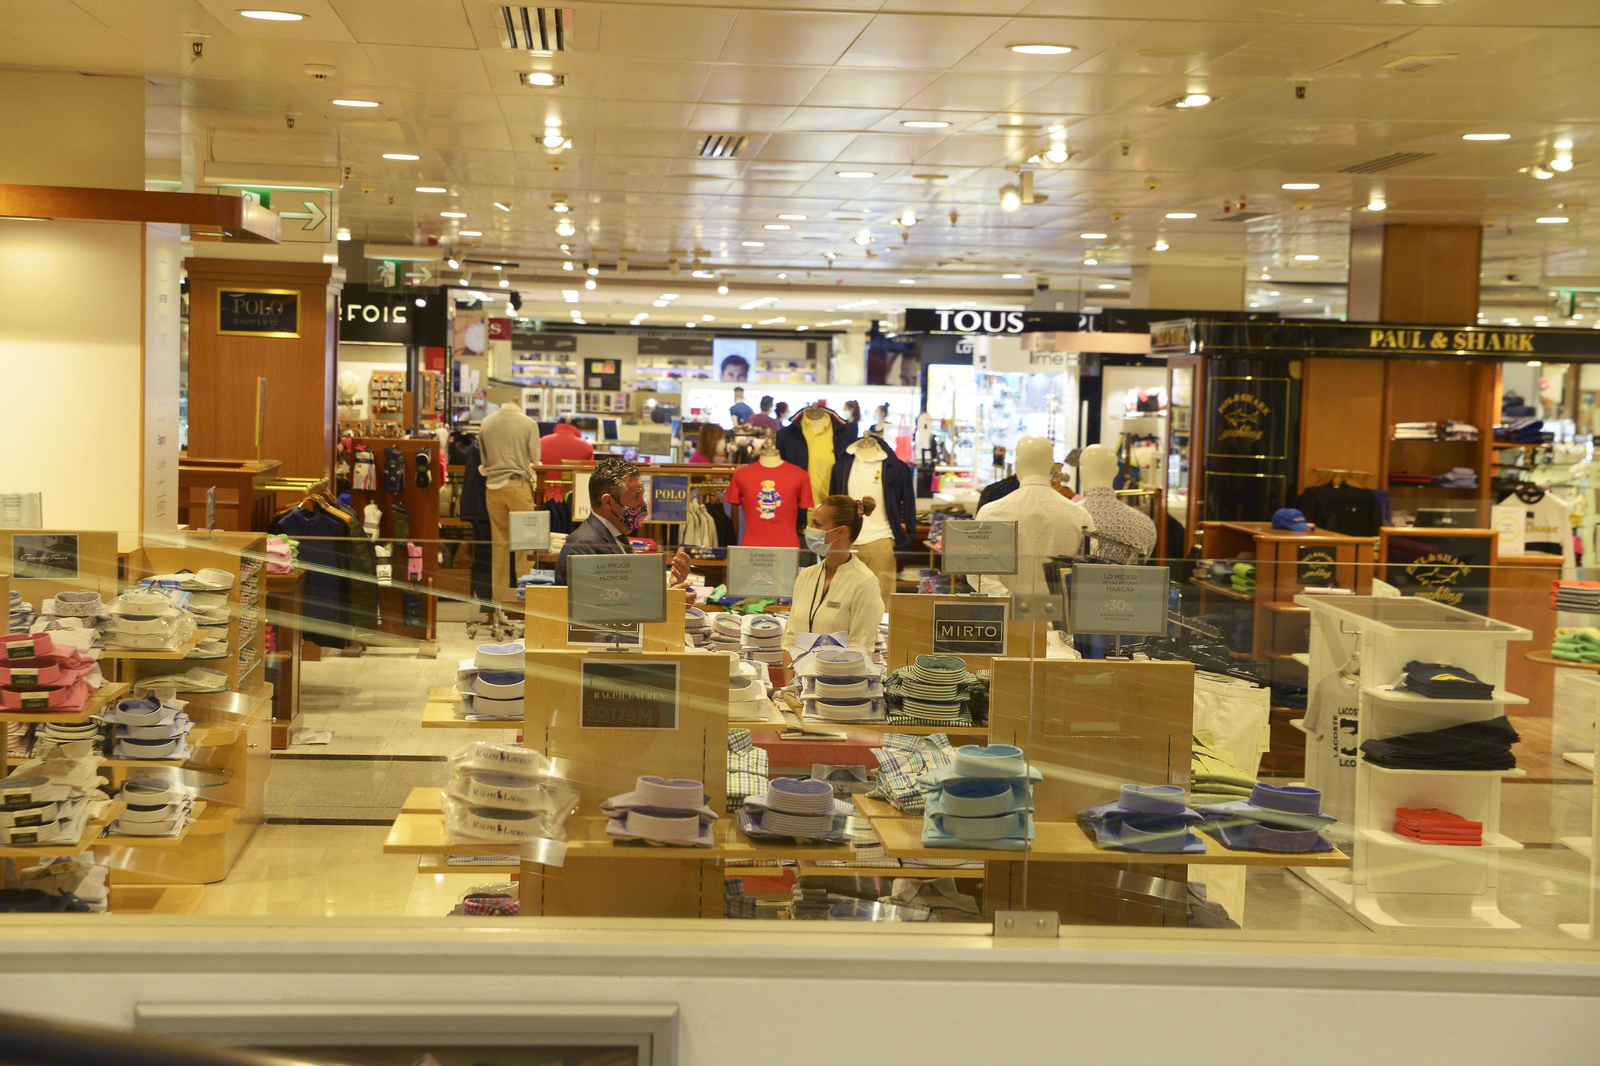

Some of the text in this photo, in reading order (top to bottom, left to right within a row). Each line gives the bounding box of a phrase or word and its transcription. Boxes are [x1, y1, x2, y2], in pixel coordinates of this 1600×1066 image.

[233, 298, 283, 316] POLO
[935, 310, 1025, 333] TOUS
[1369, 329, 1535, 352] PAUL & SHARK
[654, 489, 686, 500] POLO
[599, 588, 629, 601] -30%
[1104, 599, 1134, 611] -30%
[941, 625, 997, 638] MIRTO
[593, 691, 665, 701] RALPH LAUREN
[1338, 706, 1359, 716] LACOS
[475, 749, 533, 765] RALPH LAUREN
[473, 788, 529, 805] RALPH LAUREN
[472, 820, 529, 838] RALPH LAUREN
